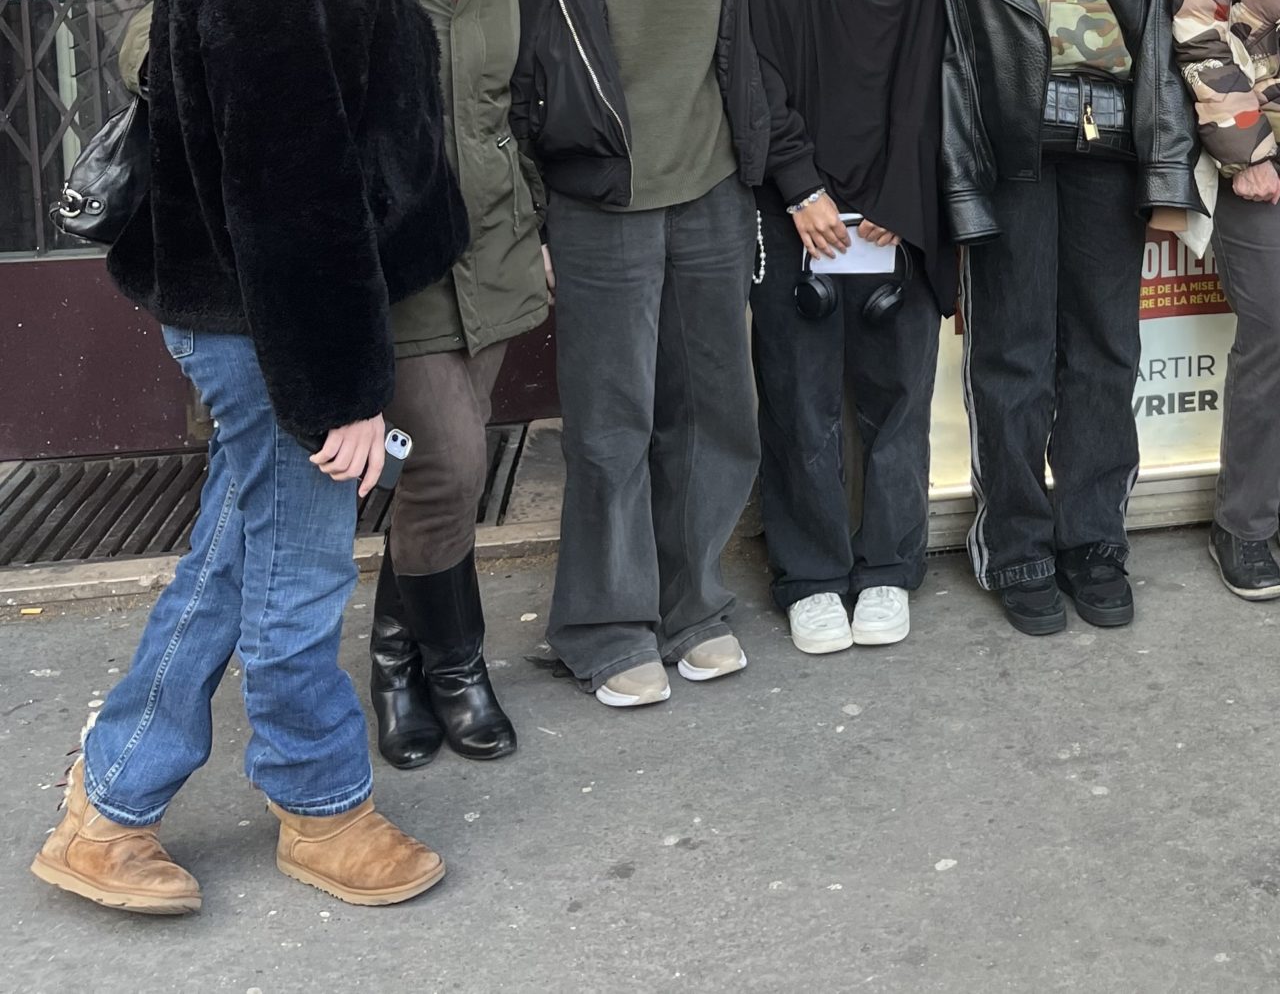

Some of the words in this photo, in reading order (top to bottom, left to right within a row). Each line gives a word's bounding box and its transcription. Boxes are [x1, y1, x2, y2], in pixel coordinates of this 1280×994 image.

[1157, 284, 1172, 294] DE
[1174, 282, 1188, 293] LA
[1190, 280, 1215, 292] MISE
[1157, 297, 1172, 307] DE
[1174, 296, 1187, 306] LA
